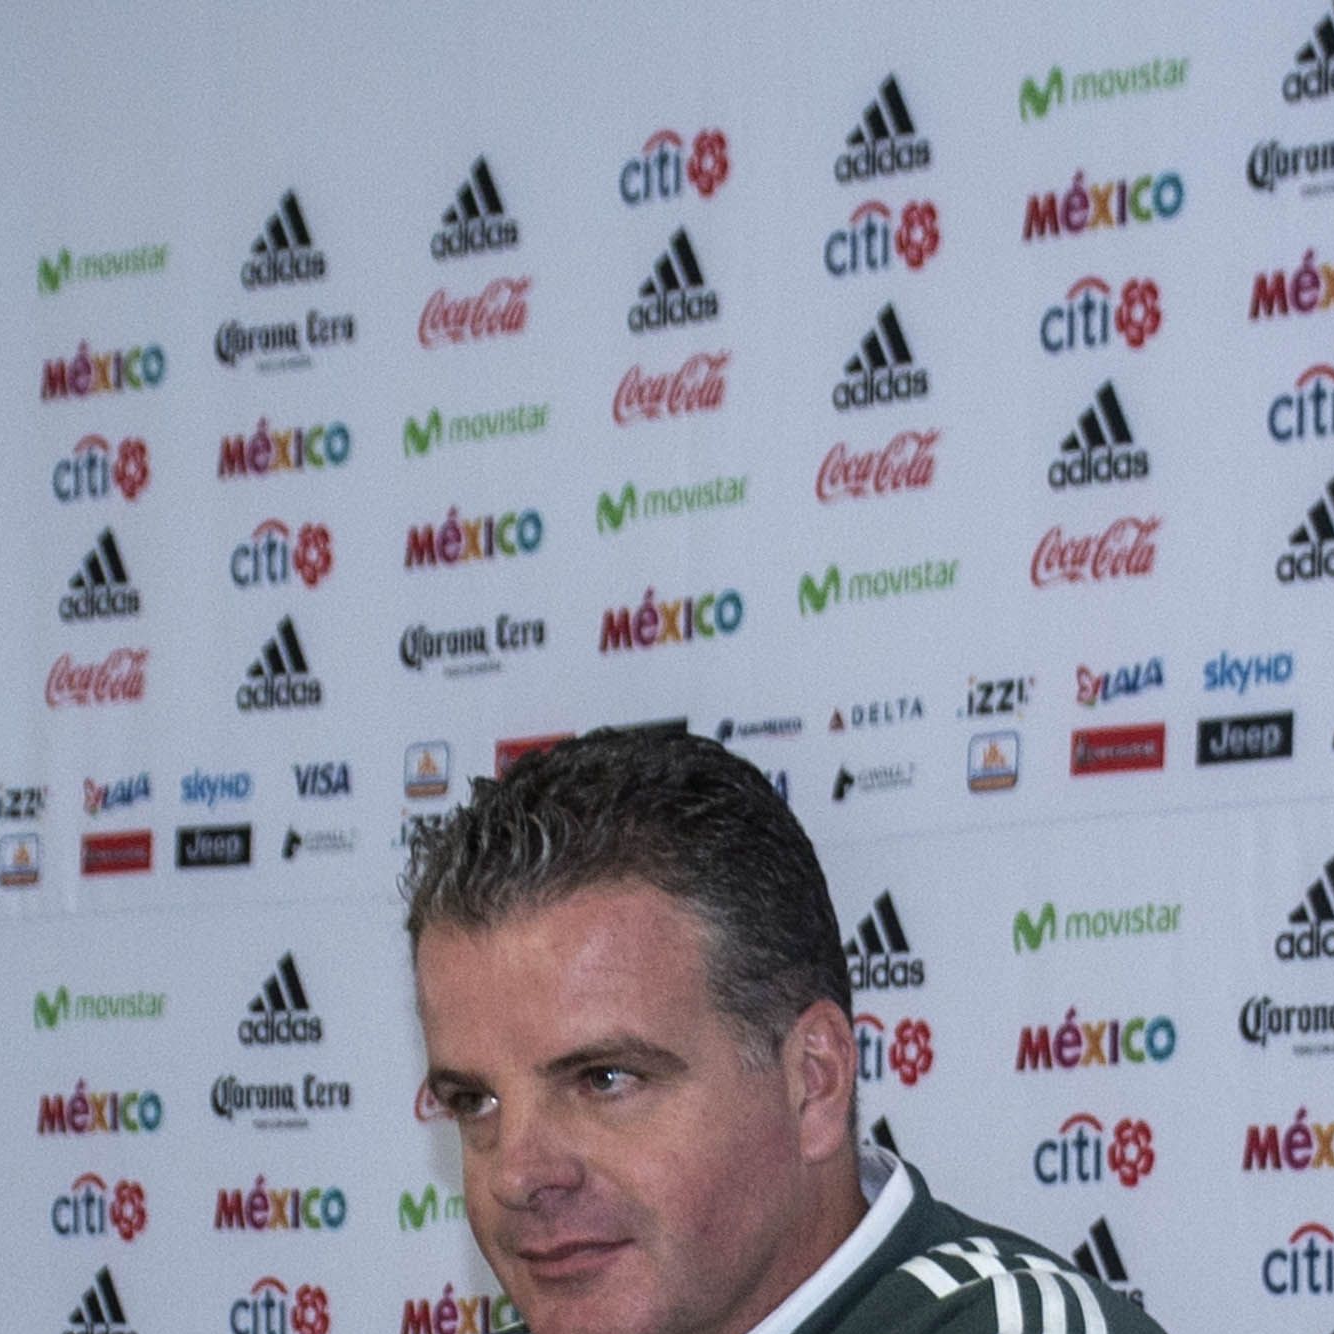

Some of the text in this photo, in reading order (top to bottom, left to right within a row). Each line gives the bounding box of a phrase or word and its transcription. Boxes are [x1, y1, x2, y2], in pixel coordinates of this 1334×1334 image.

[1071, 58, 1189, 102] movistar
[619, 145, 684, 206] citi
[835, 137, 931, 184] adidas
[431, 219, 519, 261] adidas
[824, 217, 891, 278] citi
[241, 251, 327, 290] adidas
[628, 288, 719, 333] adidas
[1040, 293, 1110, 355] citi
[214, 310, 356, 370] Corona Cero
[832, 366, 929, 412] adidas
[448, 403, 549, 443] movistar
[1048, 452, 1150, 490] adidas
[643, 476, 747, 518] movistar
[848, 560, 959, 601] movistar
[59, 588, 141, 623] adidas
[399, 614, 546, 676] Corona Cero
[236, 675, 323, 712] adidas
[851, 697, 924, 728] DELTA
[1209, 720, 1283, 755] Jeep
[294, 762, 352, 798] VISA
[1065, 903, 1182, 940] movistar
[848, 952, 924, 991] didas
[74, 991, 166, 1021] movistar
[238, 1013, 323, 1046] adidas
[210, 1074, 351, 1122] Corona Cero
[1034, 1128, 1102, 1185] citi
[51, 1189, 107, 1237] citi
[1262, 1237, 1334, 1295] citi
